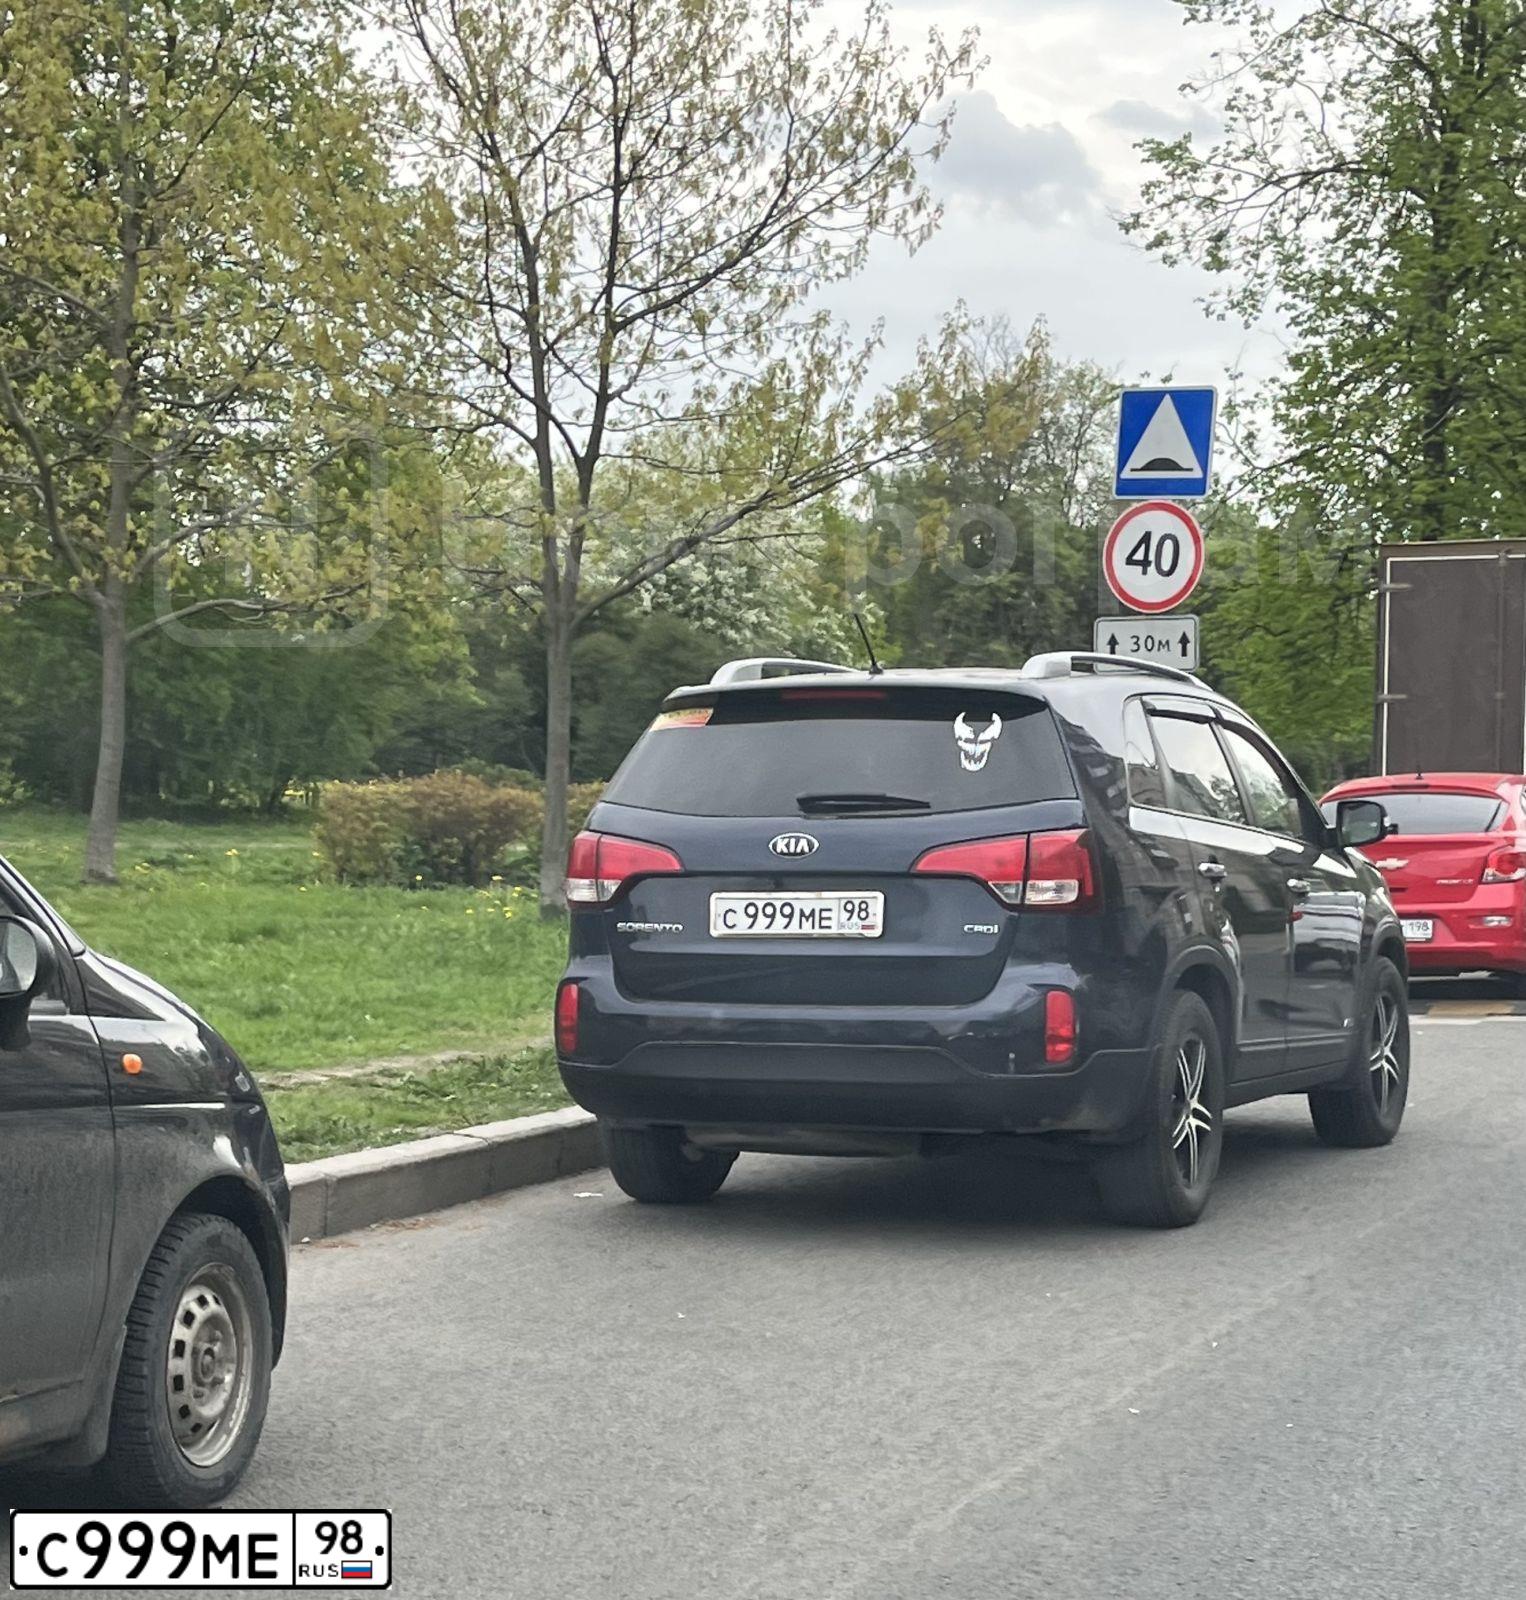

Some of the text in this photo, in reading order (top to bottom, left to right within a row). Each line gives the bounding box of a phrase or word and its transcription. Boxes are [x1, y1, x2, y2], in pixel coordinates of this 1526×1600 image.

[1125, 530, 1180, 578] 40
[776, 837, 809, 854] KIA
[843, 900, 870, 921] 98
[616, 921, 684, 934] SORENTO
